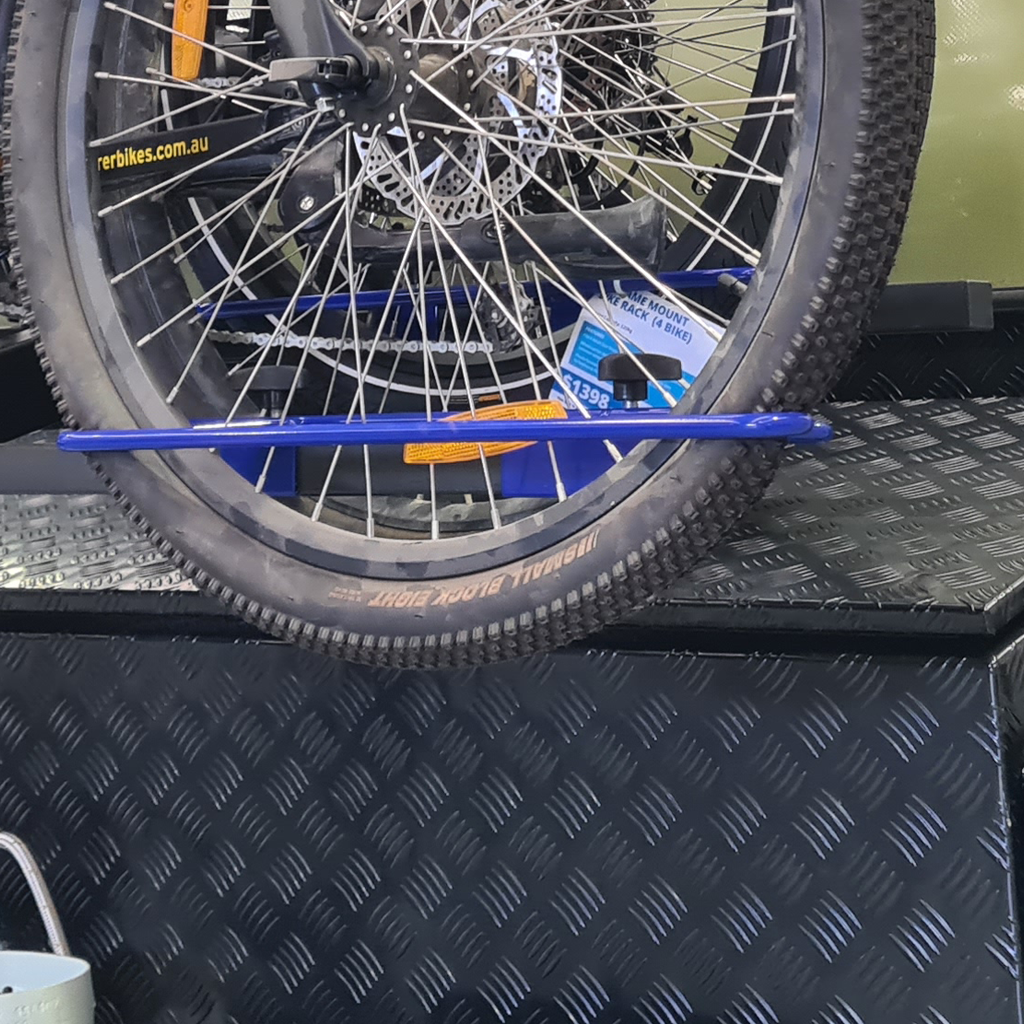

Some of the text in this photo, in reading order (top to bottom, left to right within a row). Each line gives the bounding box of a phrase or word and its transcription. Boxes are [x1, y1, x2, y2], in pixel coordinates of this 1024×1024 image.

[97, 136, 209, 171] rerbikes.com.au
[621, 300, 650, 322] RACK
[663, 322, 693, 345] BIKE)
[648, 301, 690, 327] MOUNT
[563, 374, 610, 410] $1398
[367, 589, 433, 608] EIGHT
[430, 575, 505, 606] BLOCK
